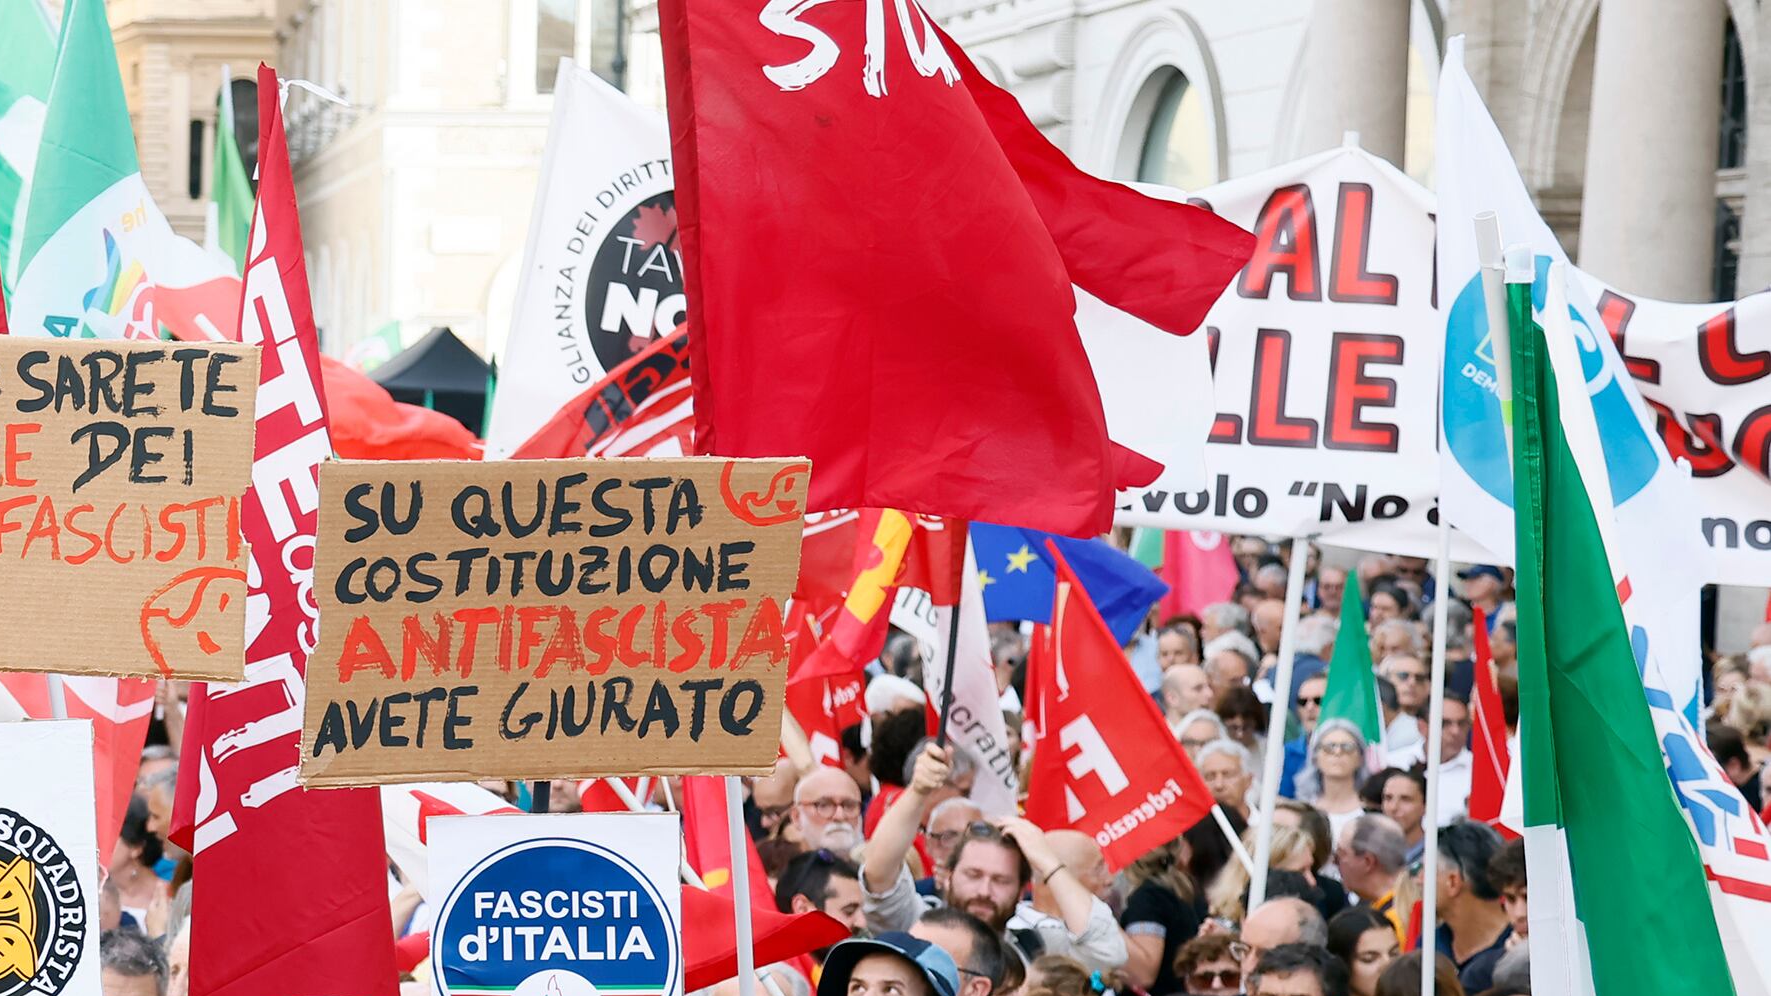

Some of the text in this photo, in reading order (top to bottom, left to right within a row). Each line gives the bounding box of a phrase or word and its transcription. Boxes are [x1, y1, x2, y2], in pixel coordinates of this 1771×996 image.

[566, 209, 600, 256] DEI
[554, 265, 592, 386] GLIANZA
[15, 347, 240, 418] SARETE
[70, 420, 193, 494] DEI
[343, 472, 708, 543] SU QUESTA
[334, 540, 757, 605] COSTITUZIONE
[336, 595, 790, 684] ANTIFASCISTA
[311, 676, 766, 758] AVETE GIURATO
[475, 890, 638, 919] FASCISTI
[458, 926, 656, 961] d’ITALIA
